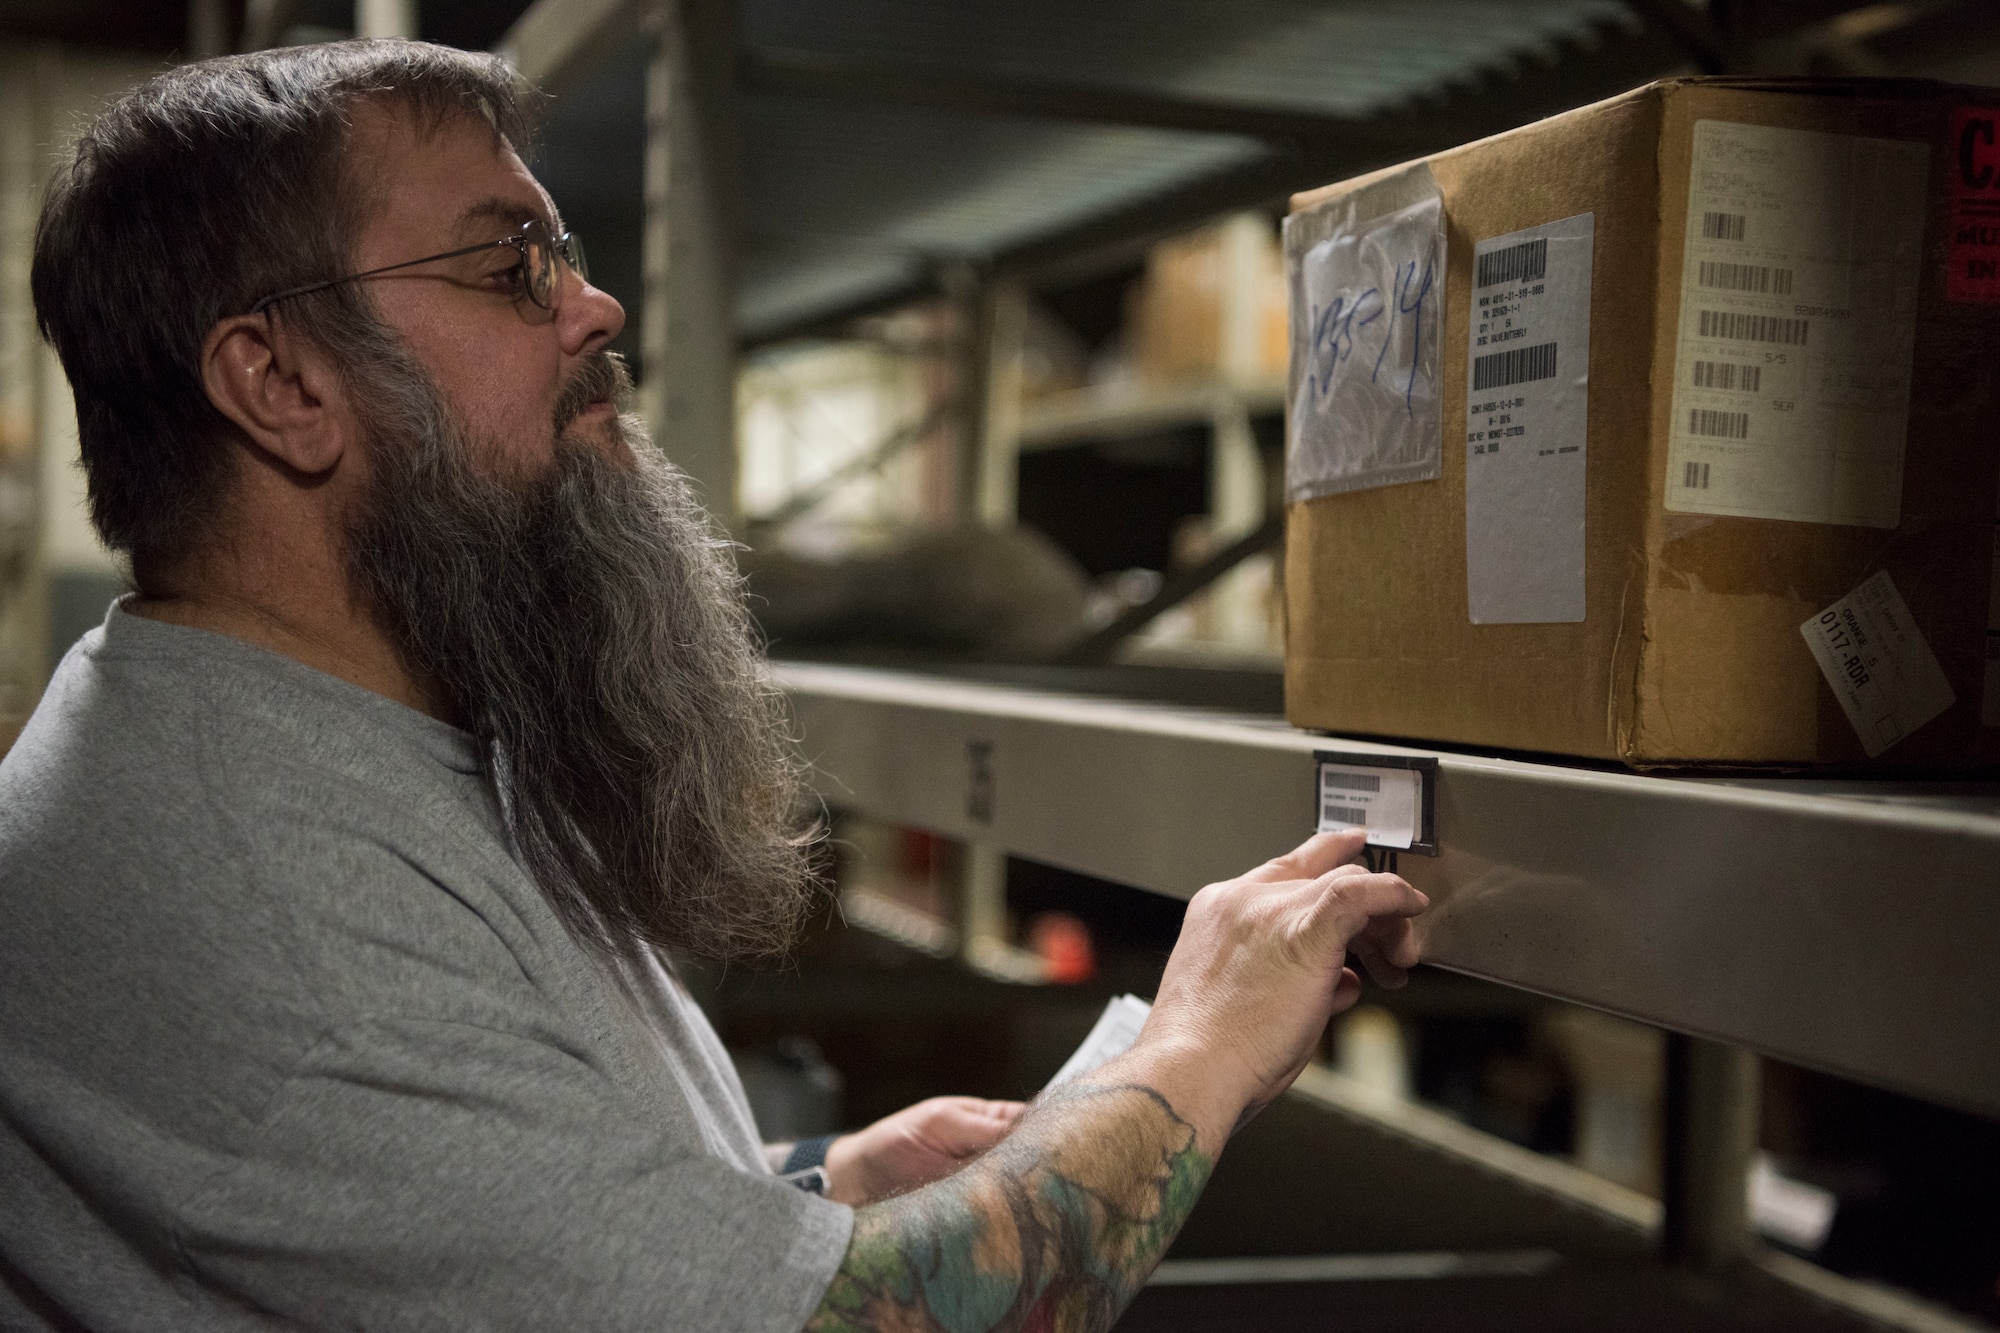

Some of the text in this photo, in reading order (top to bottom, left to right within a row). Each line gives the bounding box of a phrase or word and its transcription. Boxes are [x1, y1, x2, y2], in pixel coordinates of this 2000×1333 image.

[1960, 118, 2000, 189] C
[1820, 611, 1870, 689] 0117-RDR
[1842, 608, 1869, 648] ORANGE
